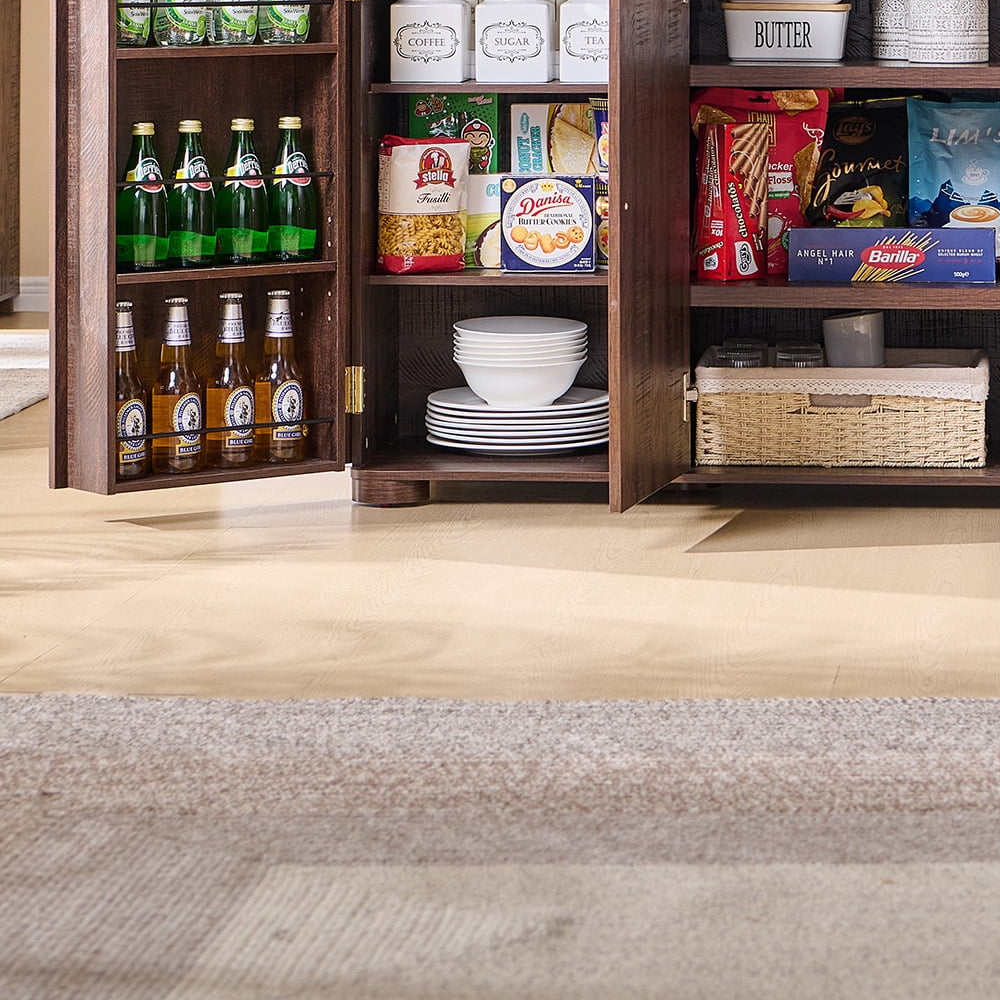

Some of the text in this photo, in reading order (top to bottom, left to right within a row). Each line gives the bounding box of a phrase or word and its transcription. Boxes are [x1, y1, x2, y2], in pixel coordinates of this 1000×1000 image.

[754, 20, 812, 48] BUTTER
[408, 37, 446, 47] COFFEE
[494, 37, 530, 47] SUGAR
[584, 36, 604, 45] TEA
[837, 119, 873, 136] Lay's
[422, 170, 449, 182] stella
[813, 148, 908, 206] Gourmet
[416, 193, 451, 204] Fusilli
[515, 191, 573, 217] Danisa
[518, 217, 577, 226] BUTTER COOKIES
[797, 249, 827, 257] ANGEL
[868, 250, 918, 263] Barilla
